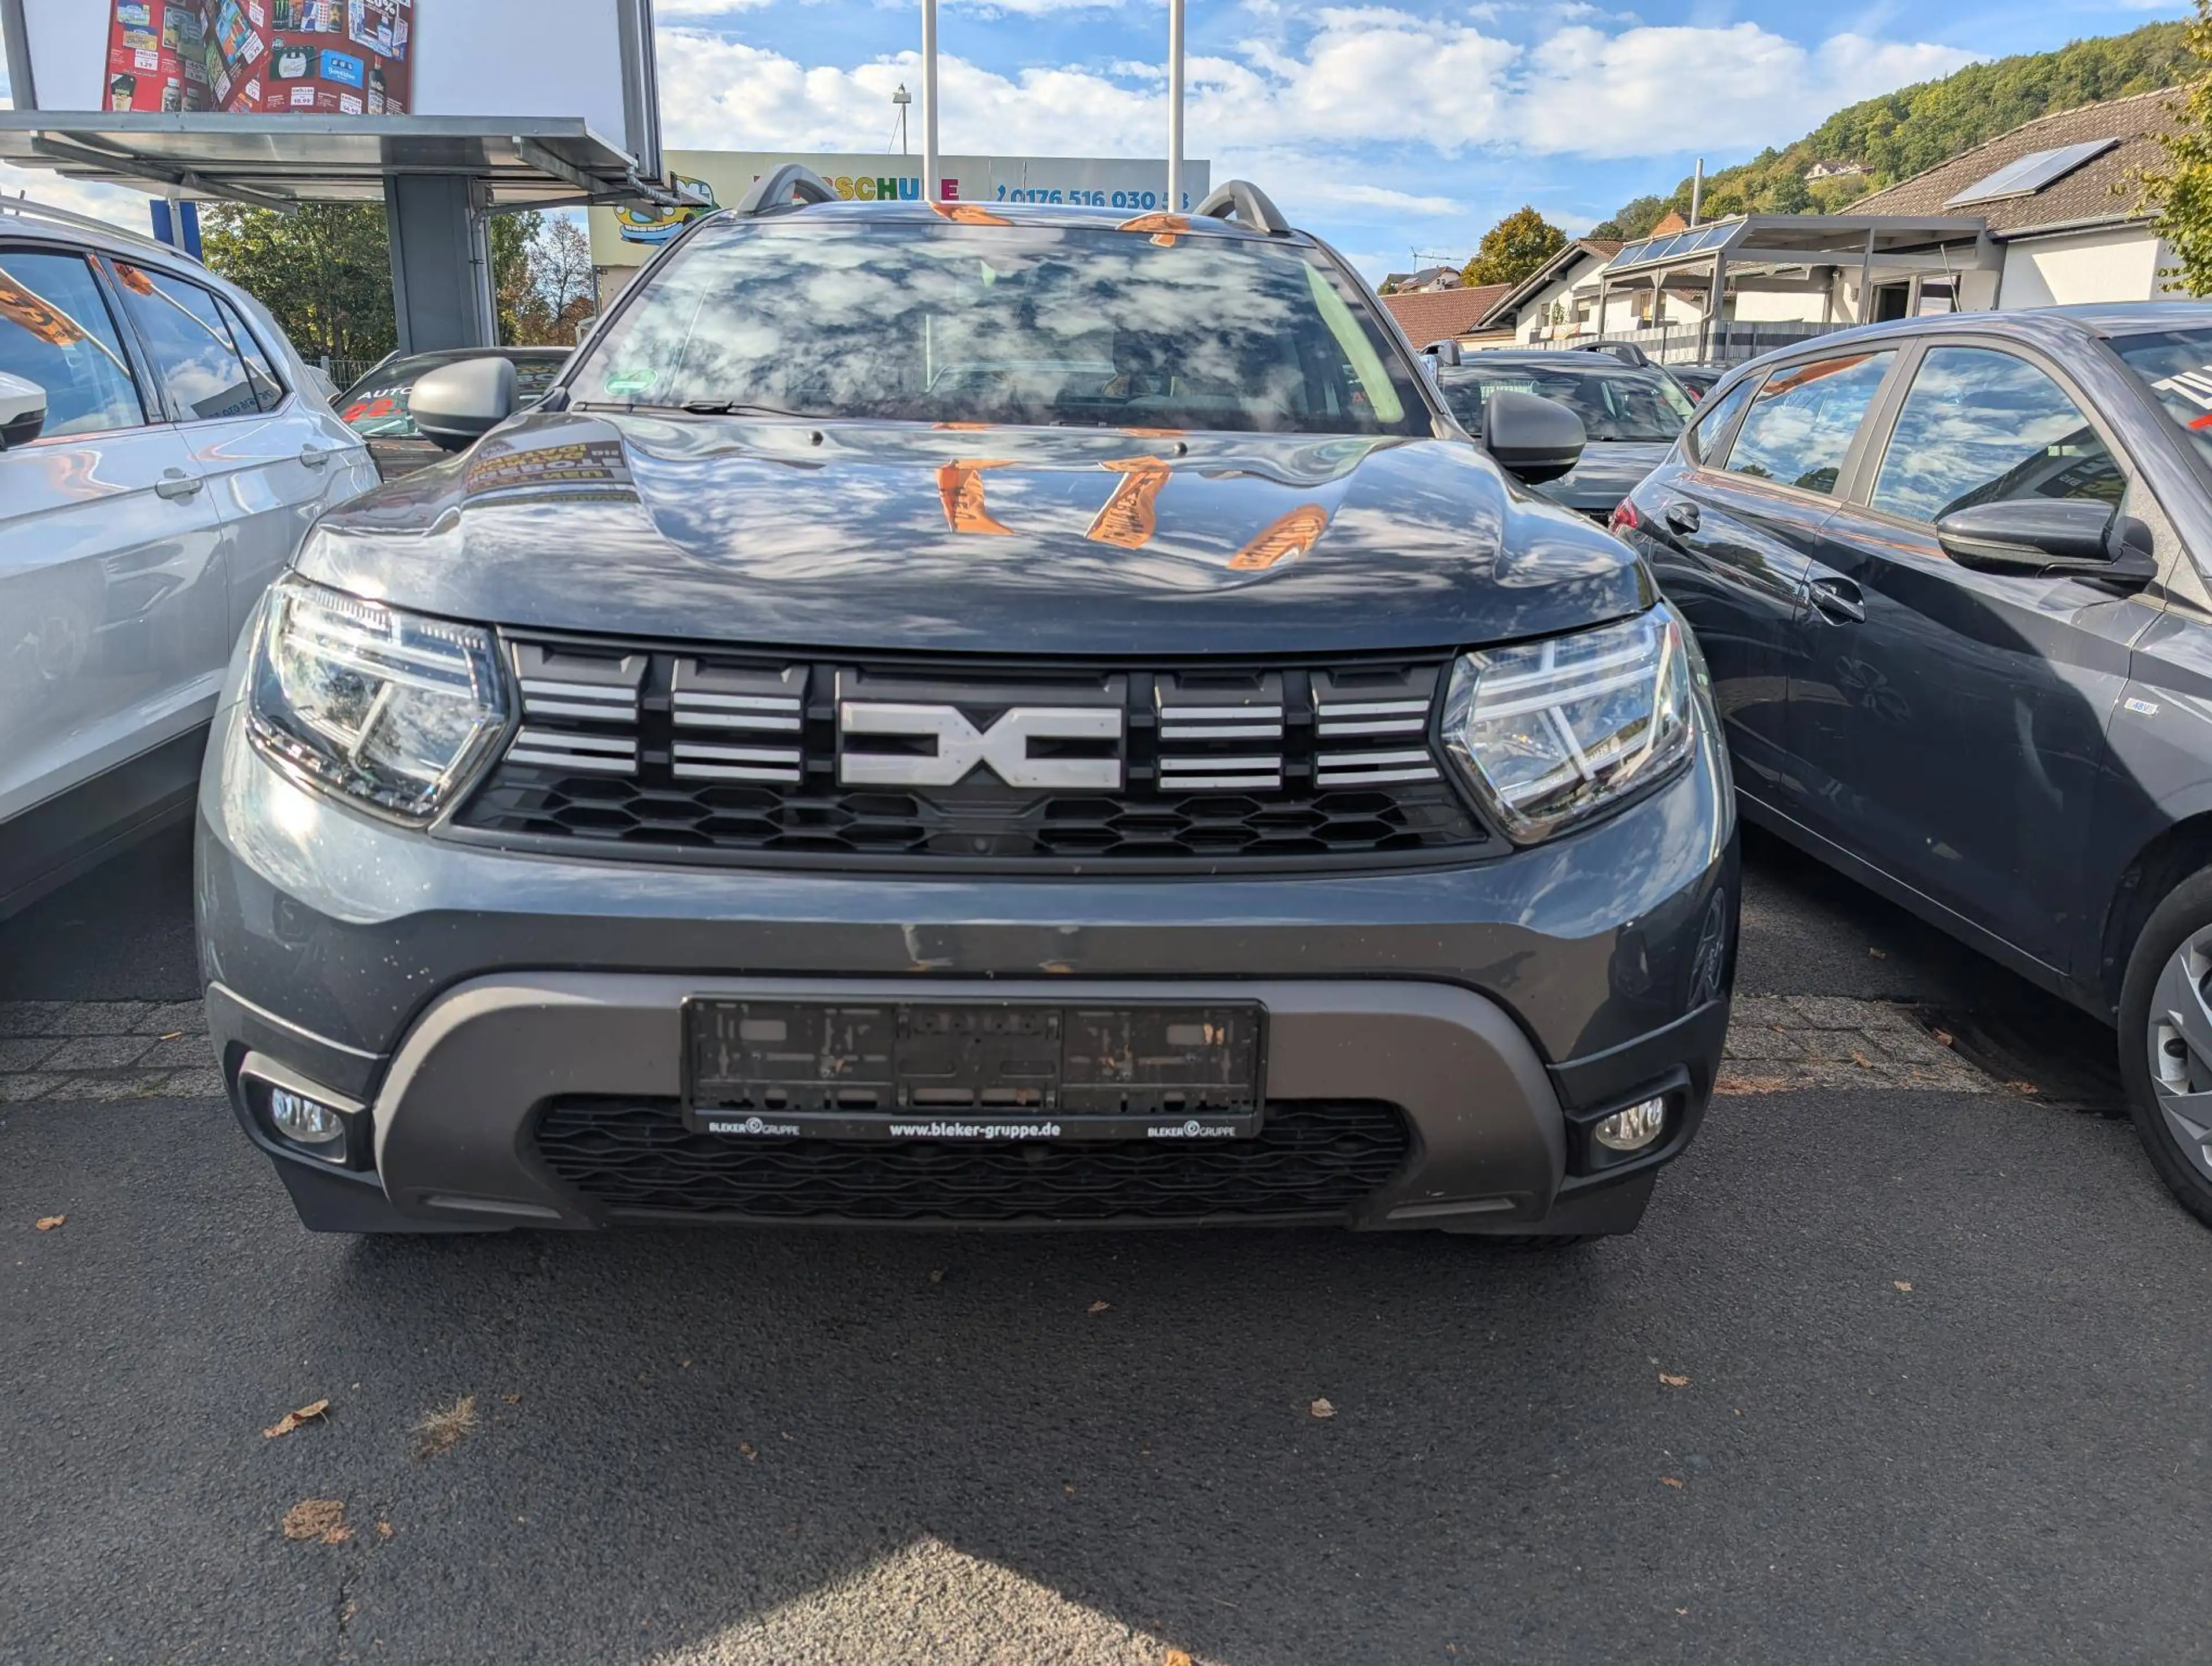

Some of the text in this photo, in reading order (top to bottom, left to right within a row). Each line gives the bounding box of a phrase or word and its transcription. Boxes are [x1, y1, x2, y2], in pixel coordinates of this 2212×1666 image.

[1011, 189, 1062, 204] 0176
[1069, 190, 1105, 207] 516
[1111, 191, 1155, 209] 030
[709, 1122, 800, 1135] BLEKER GRUPPE
[889, 1122, 1061, 1139] www.bleker-gruppe.de
[1148, 1126, 1236, 1137] BLEKER GRUPPE
